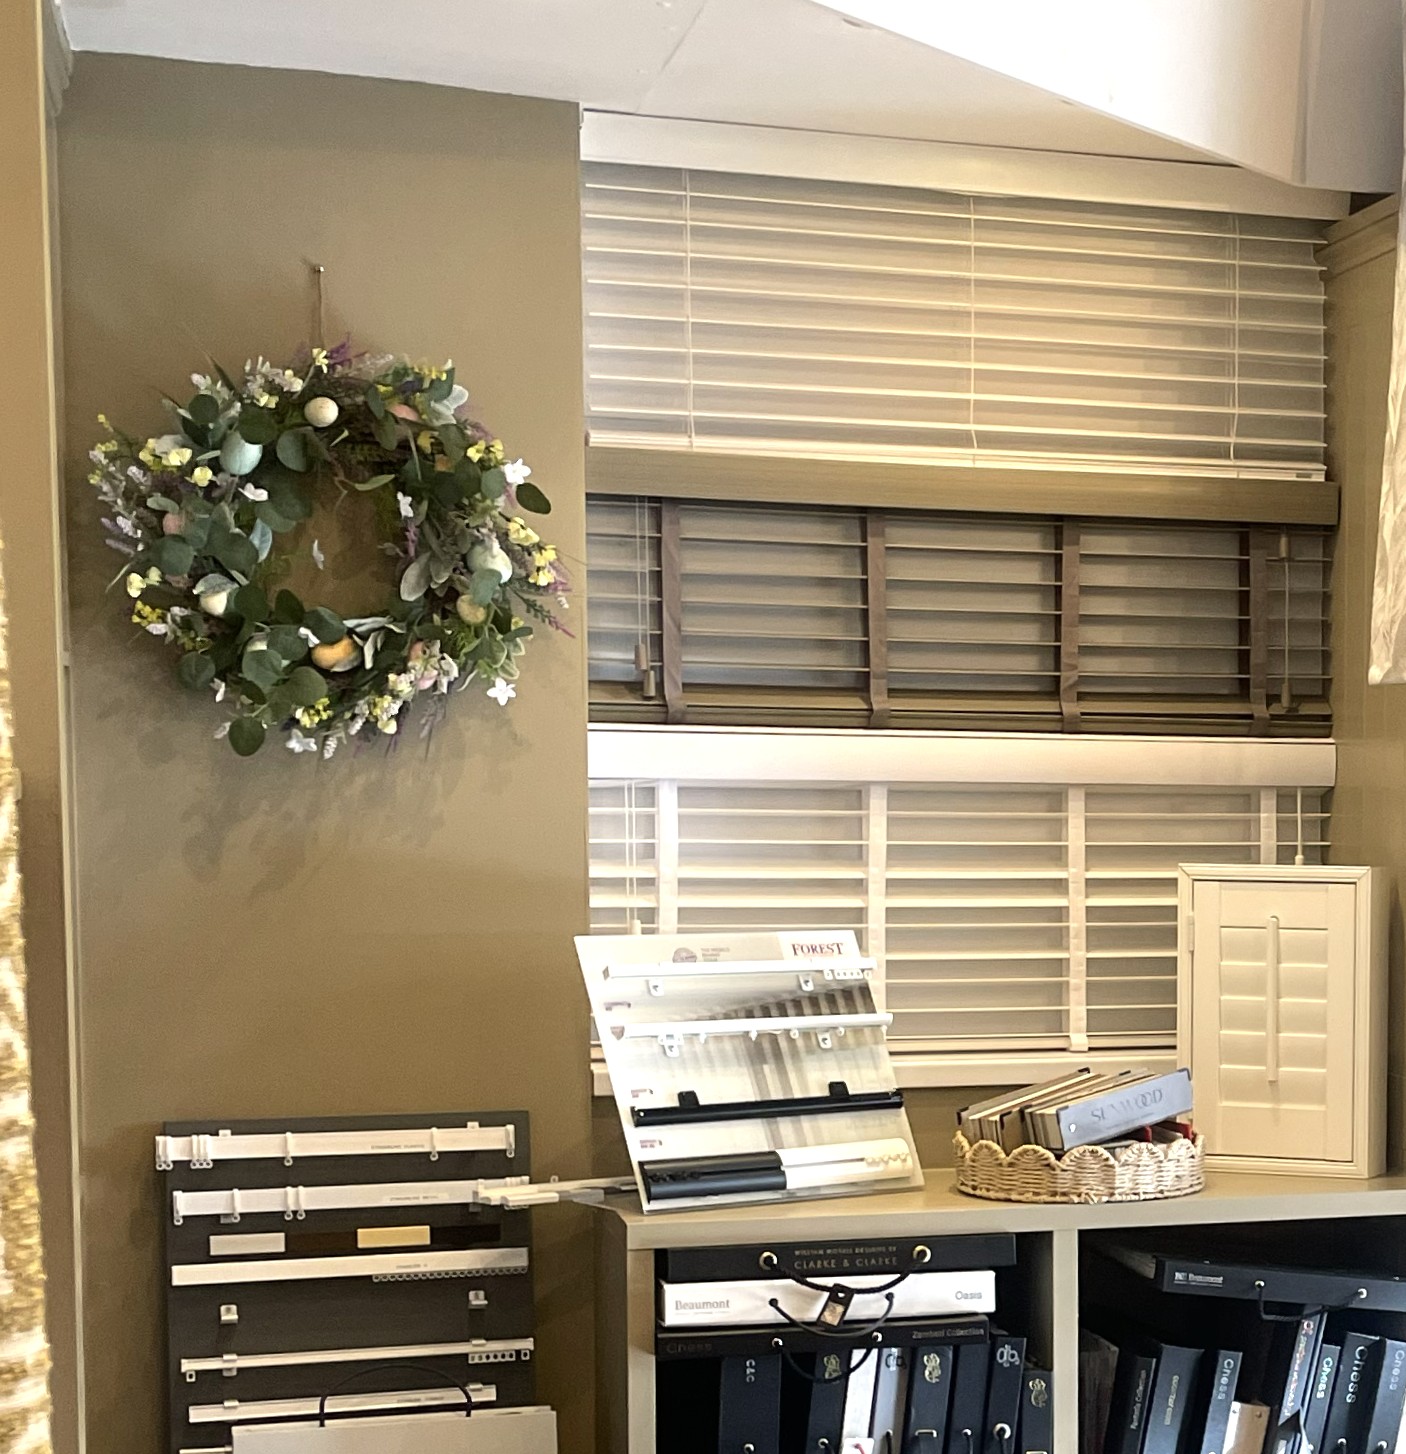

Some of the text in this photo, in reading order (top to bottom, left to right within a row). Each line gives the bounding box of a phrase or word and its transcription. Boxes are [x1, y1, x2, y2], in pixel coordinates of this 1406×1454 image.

[791, 942, 844, 957] FOREST
[794, 1256, 898, 1270] CLARKE & CLARKE
[674, 1290, 983, 1312] Beaumont Oasis
[1217, 1357, 1236, 1401] Chess
[1315, 1356, 1333, 1400] Chess
[1345, 1344, 1369, 1405] Chess
[1388, 1349, 1406, 1392] Chess
